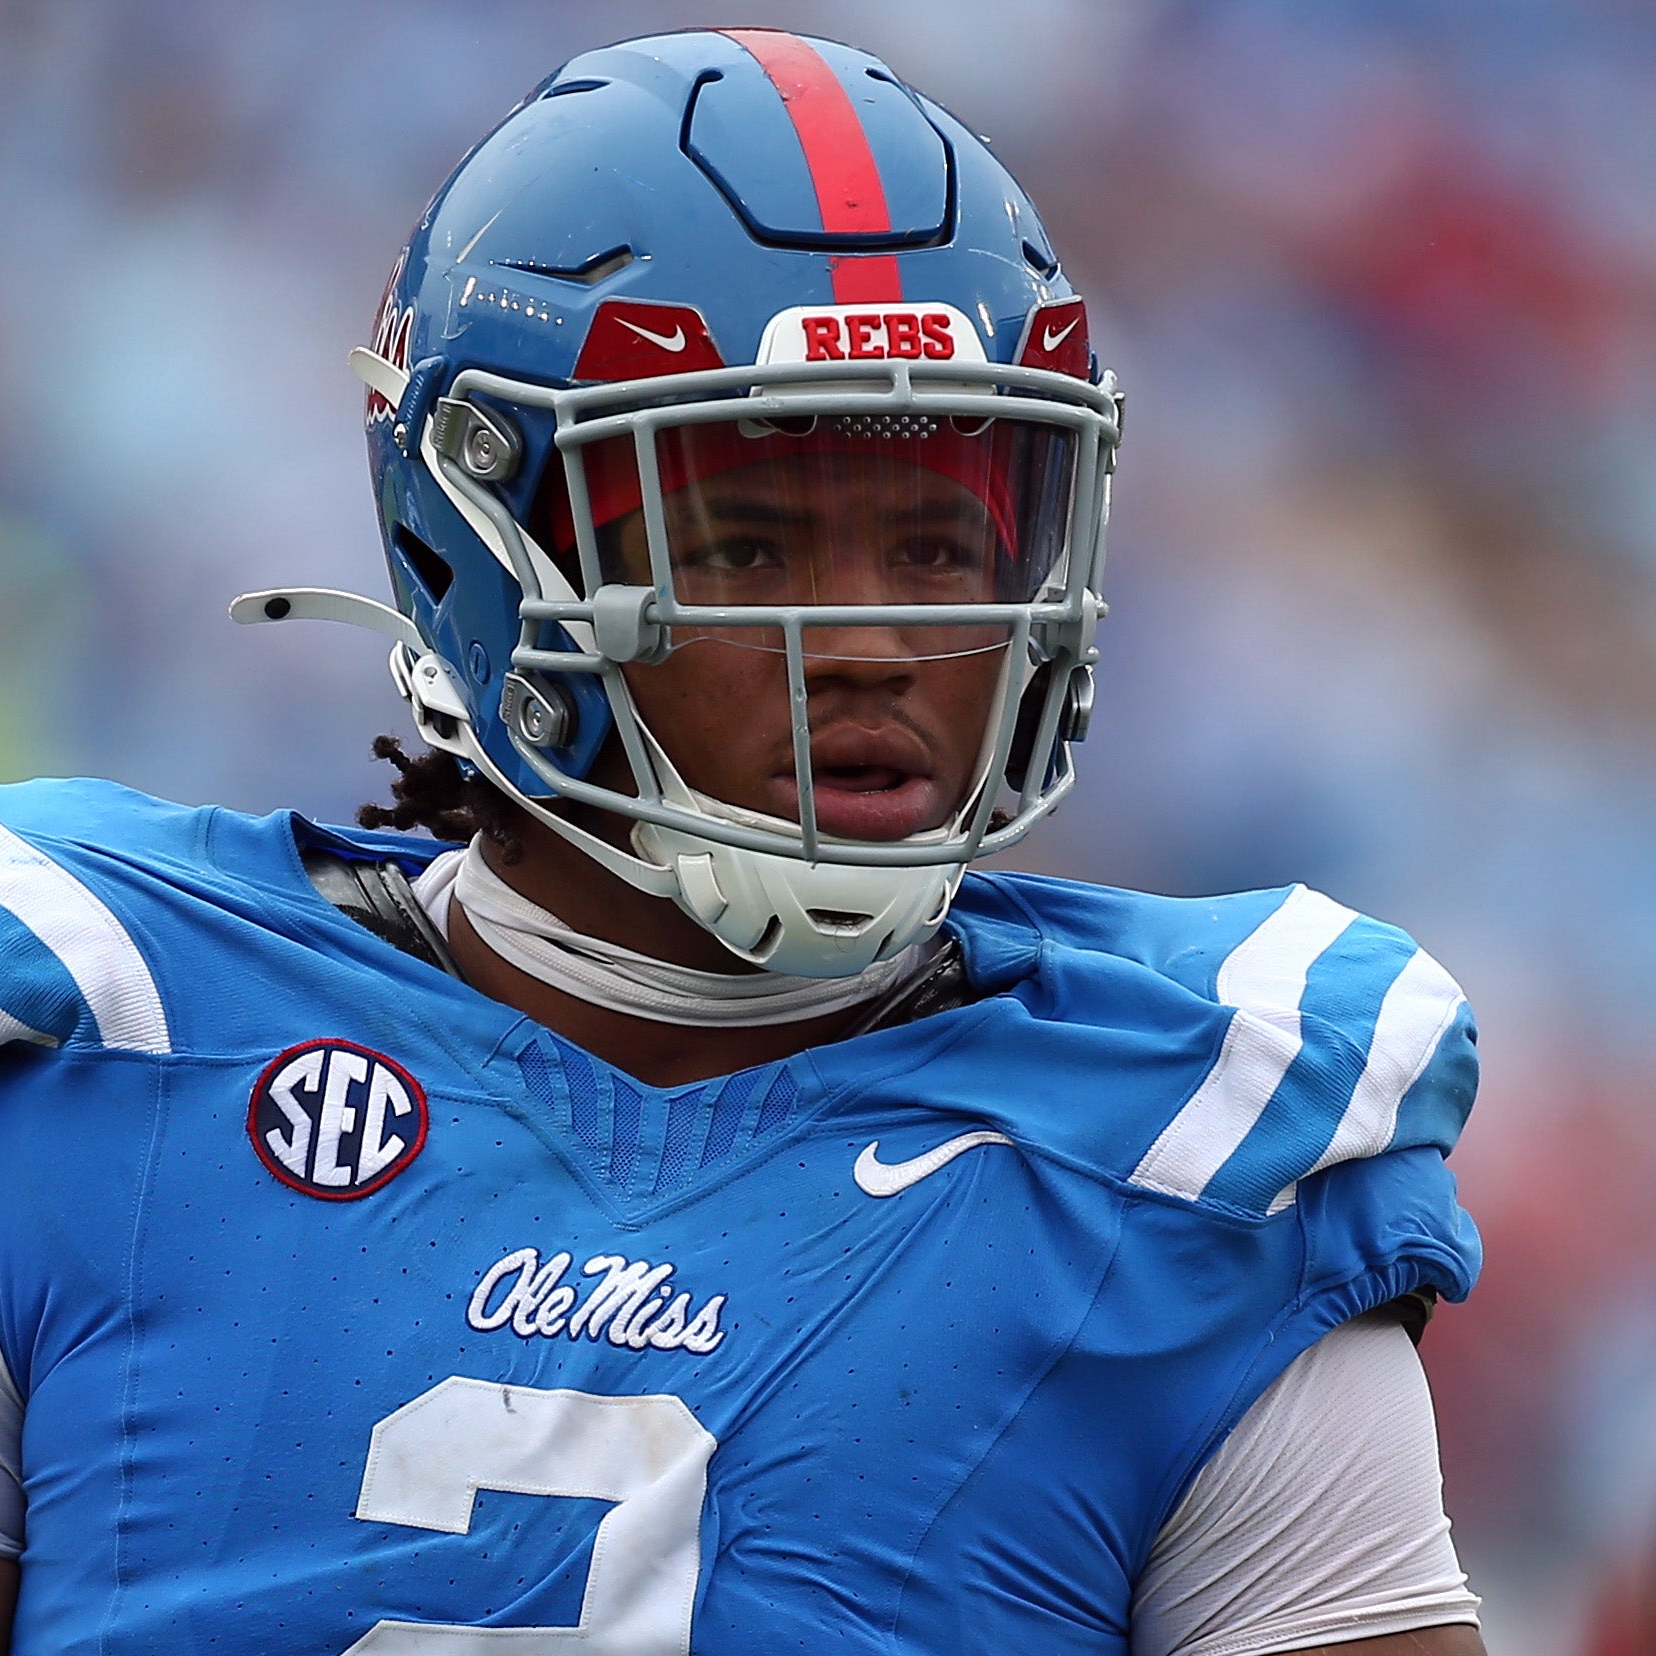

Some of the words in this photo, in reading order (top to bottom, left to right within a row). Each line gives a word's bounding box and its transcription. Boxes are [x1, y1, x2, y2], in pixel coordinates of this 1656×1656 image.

[802, 313, 955, 361] REBS
[265, 1049, 413, 1187] SEC
[466, 1247, 574, 1338] Ole
[567, 1254, 726, 1353] Miss
